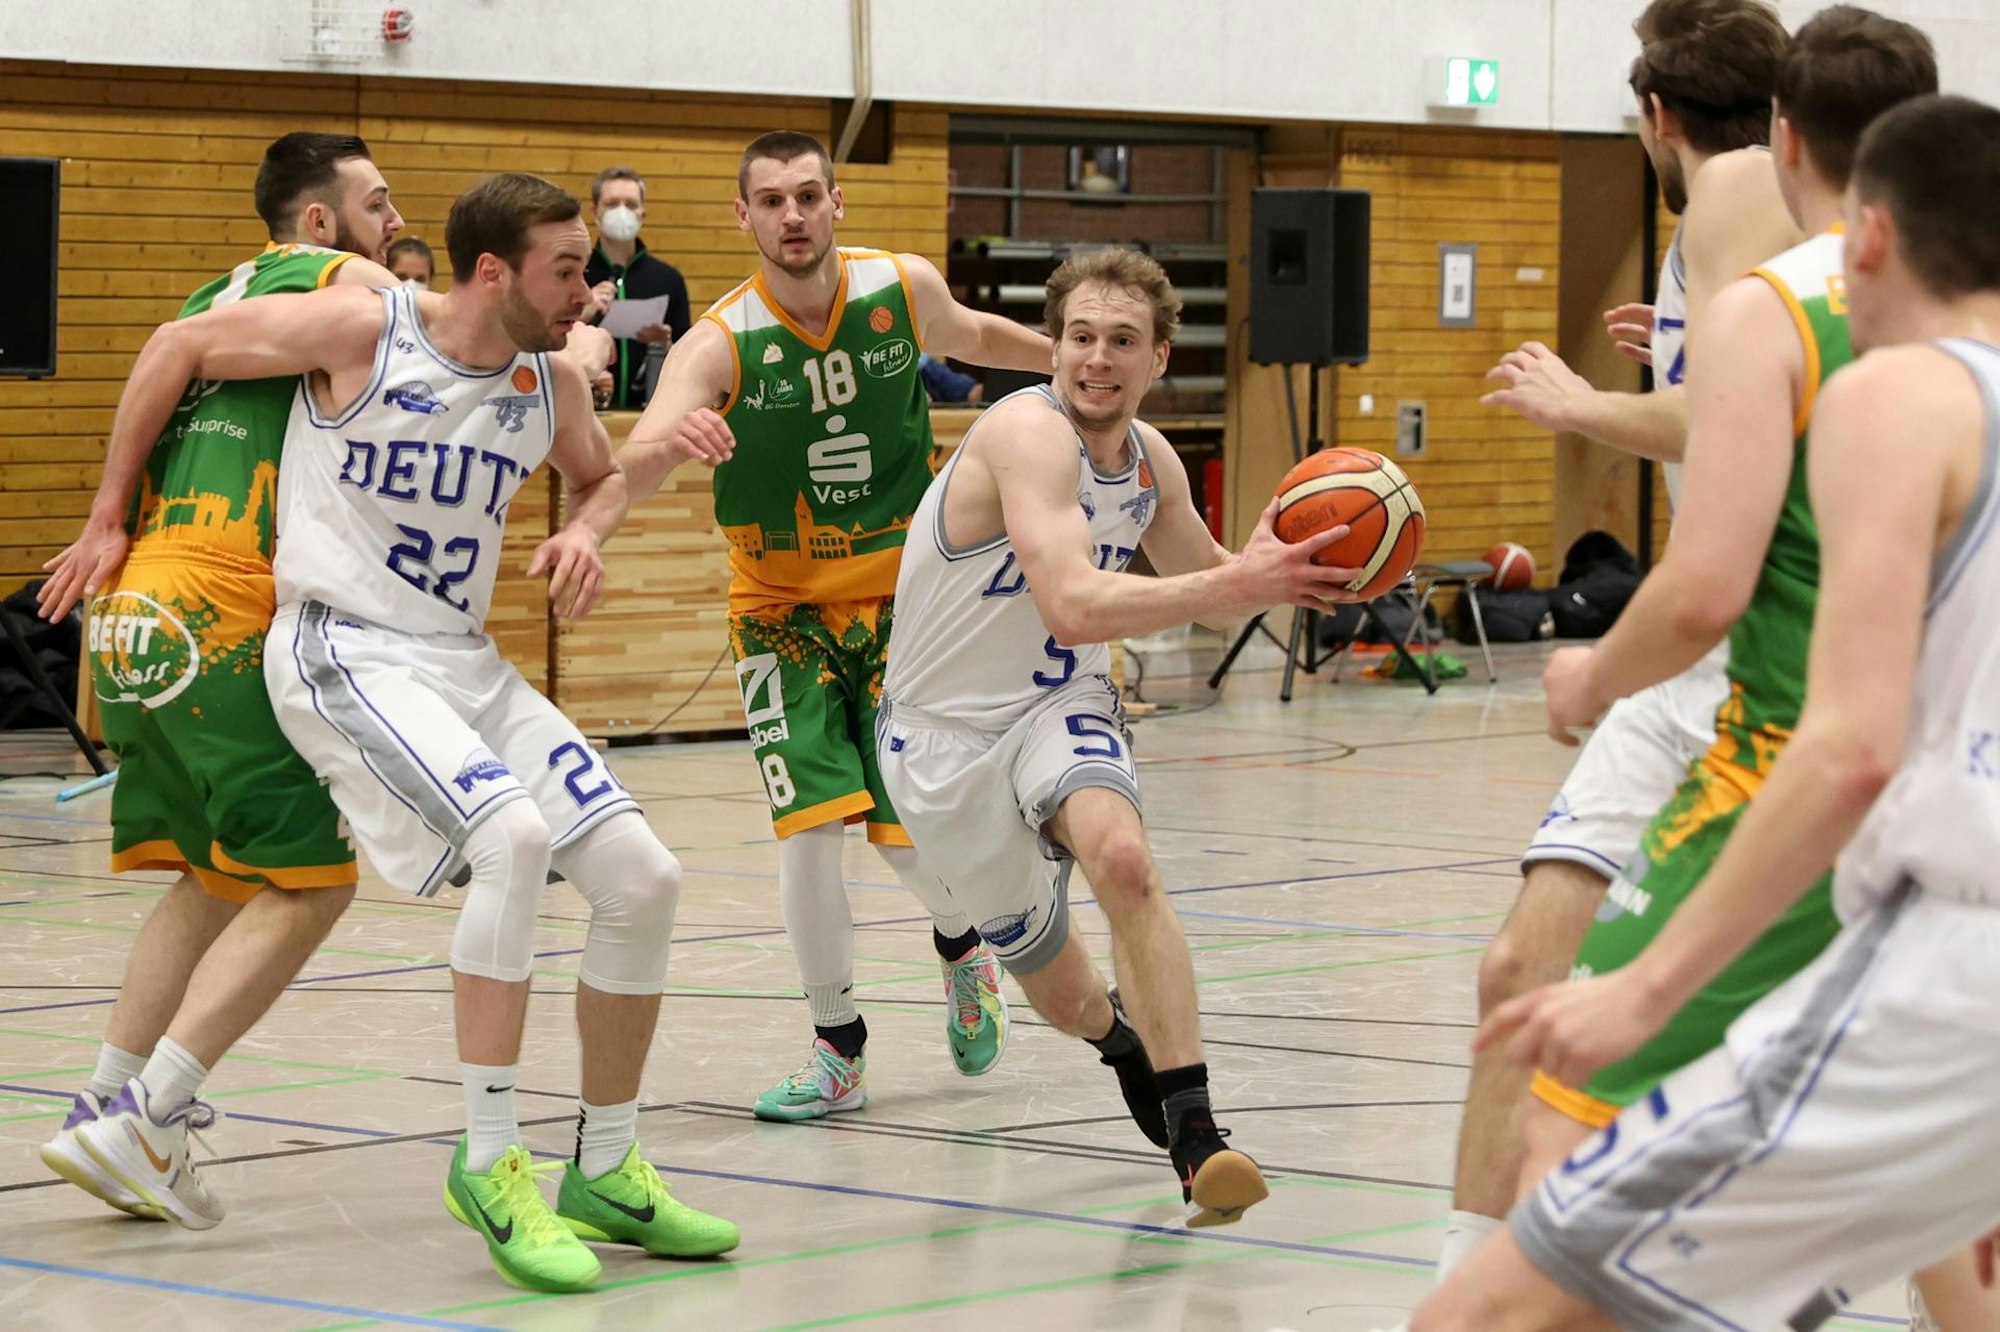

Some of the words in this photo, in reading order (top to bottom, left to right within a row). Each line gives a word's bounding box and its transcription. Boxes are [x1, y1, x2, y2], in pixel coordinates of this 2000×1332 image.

[395, 336, 414, 354] 43
[872, 349, 887, 365] BE
[889, 341, 904, 359] FIT
[803, 348, 858, 414] 18
[495, 399, 527, 433] 43
[339, 439, 530, 526] DEUT
[813, 483, 872, 504] Vest
[386, 523, 480, 612] 22
[1065, 713, 1123, 762] 5
[548, 741, 624, 810] 2
[758, 753, 797, 811] 8
